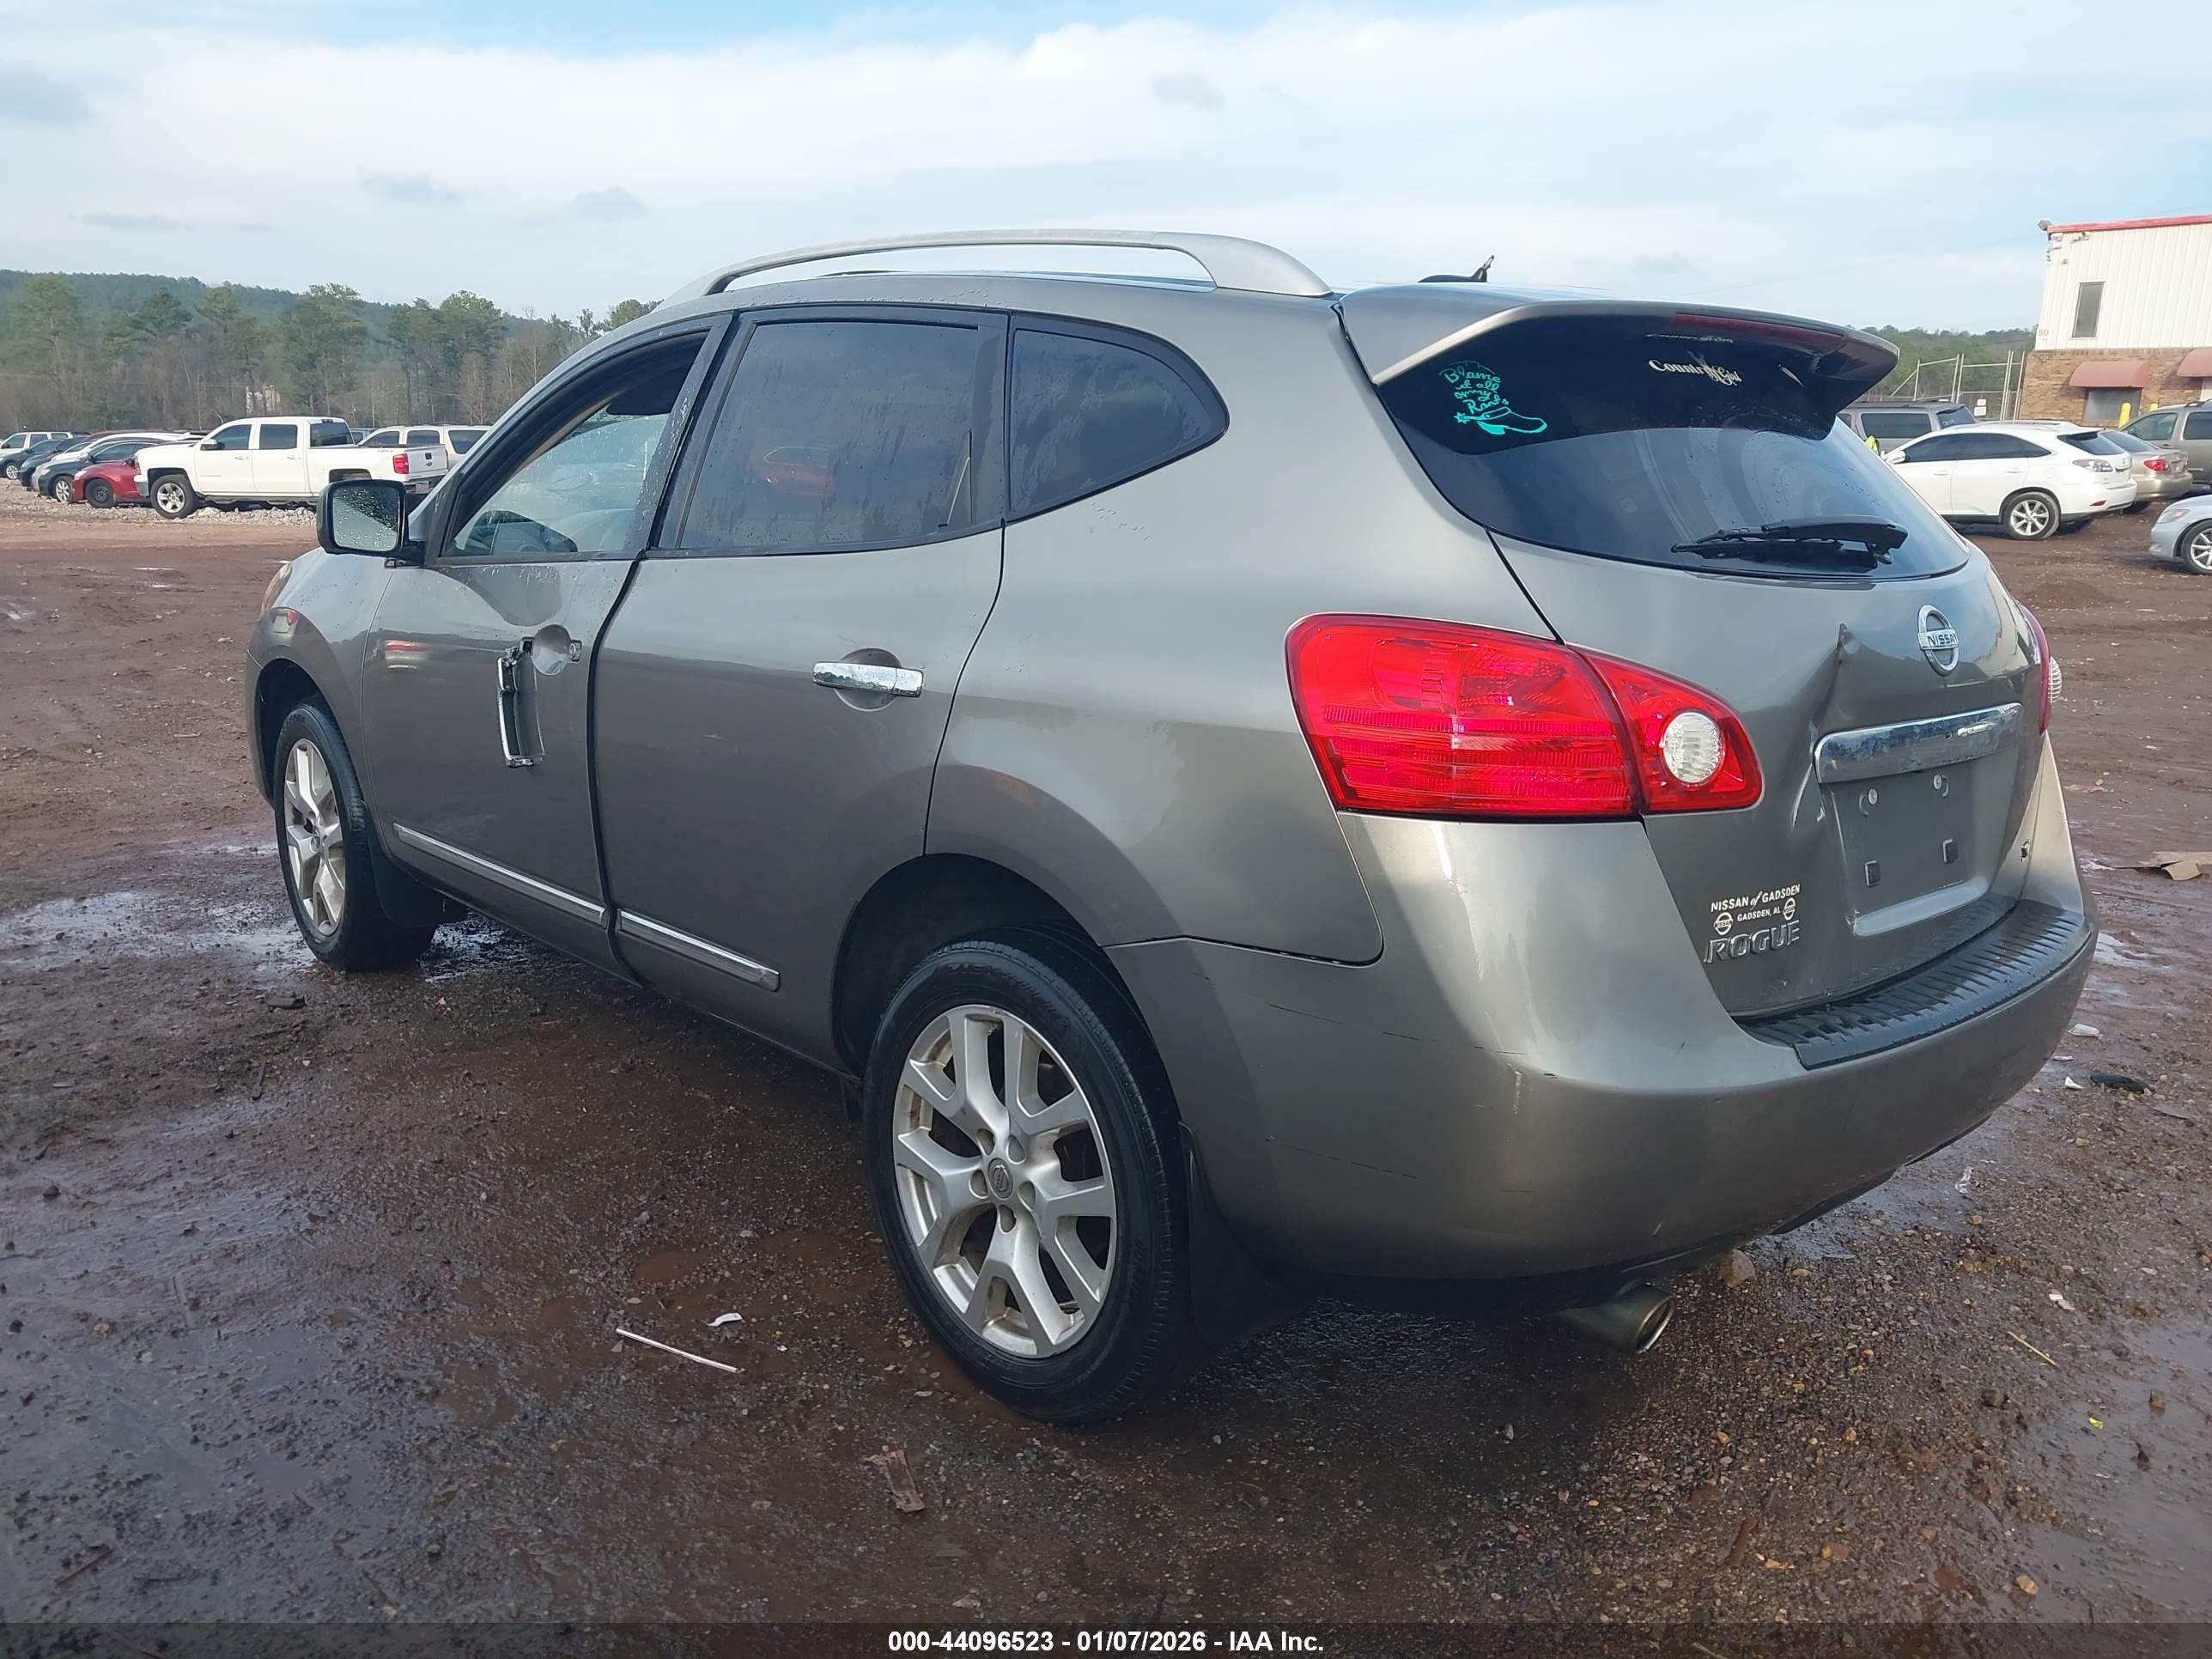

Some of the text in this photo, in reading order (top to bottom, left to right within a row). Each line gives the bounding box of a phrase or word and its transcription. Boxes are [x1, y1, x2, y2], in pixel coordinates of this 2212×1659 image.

[1440, 365, 1502, 384] Blame
[1476, 380, 1500, 394] all
[1927, 633, 1959, 647] NISSAN
[1711, 884, 1801, 912] NISSAN of GADSDEN
[1737, 906, 1781, 921] GADSDEN, AL
[1704, 920, 1801, 963] ROGUE
